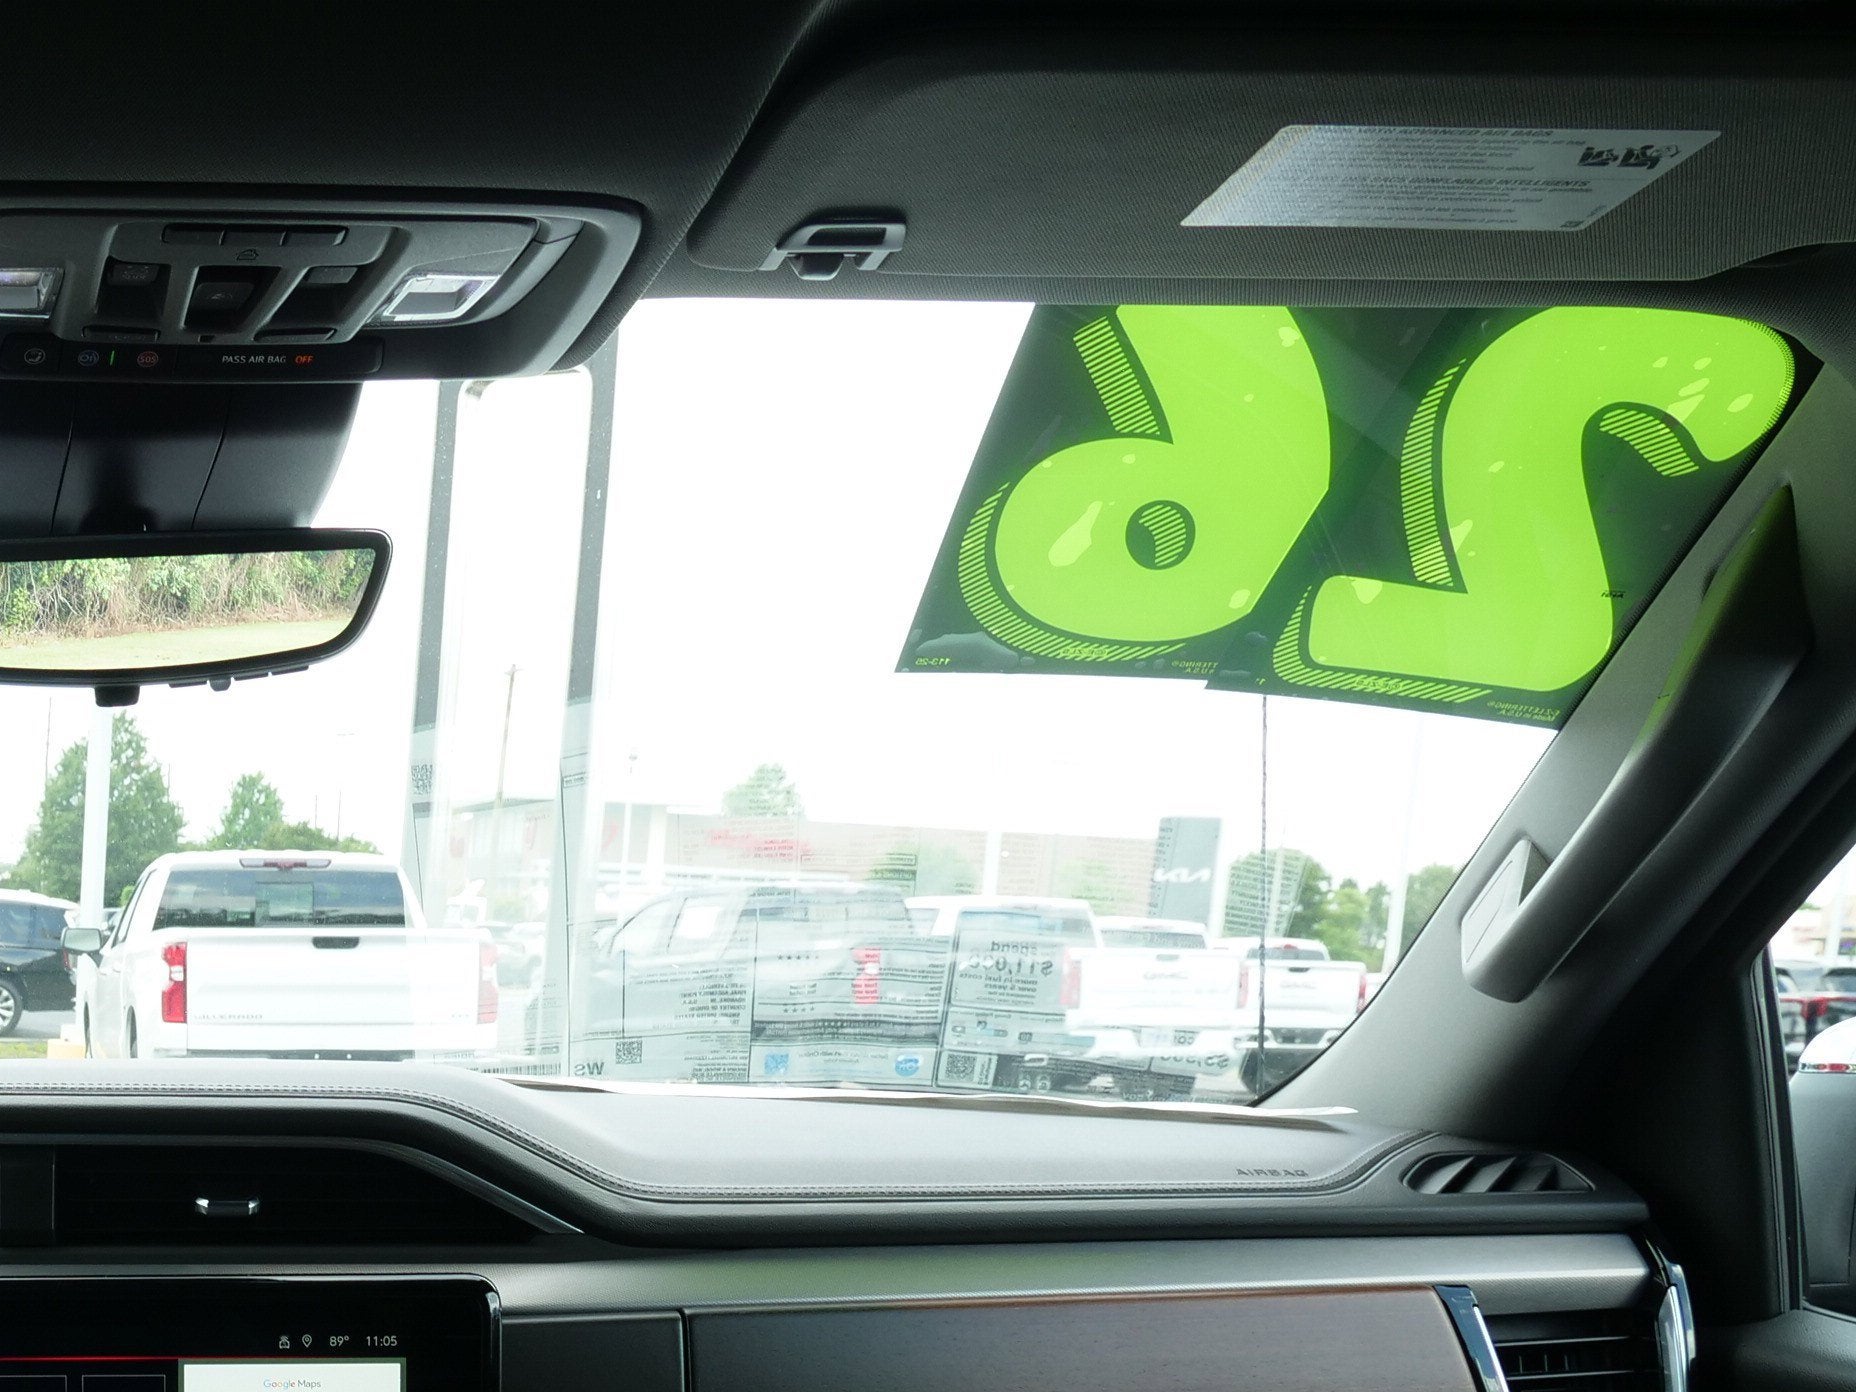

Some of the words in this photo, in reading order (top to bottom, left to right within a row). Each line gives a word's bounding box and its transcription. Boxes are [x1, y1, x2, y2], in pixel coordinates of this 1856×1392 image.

[138, 355, 157, 364] SOS
[222, 354, 245, 364] PASS
[249, 354, 265, 364] AIR
[267, 354, 287, 364] BAG
[293, 354, 315, 365] OFF
[1236, 1168, 1310, 1177] AIRBAG
[329, 1335, 350, 1347] 89°
[366, 1335, 398, 1347] 11:05
[263, 1379, 295, 1391] Google
[297, 1379, 322, 1391] Maps
